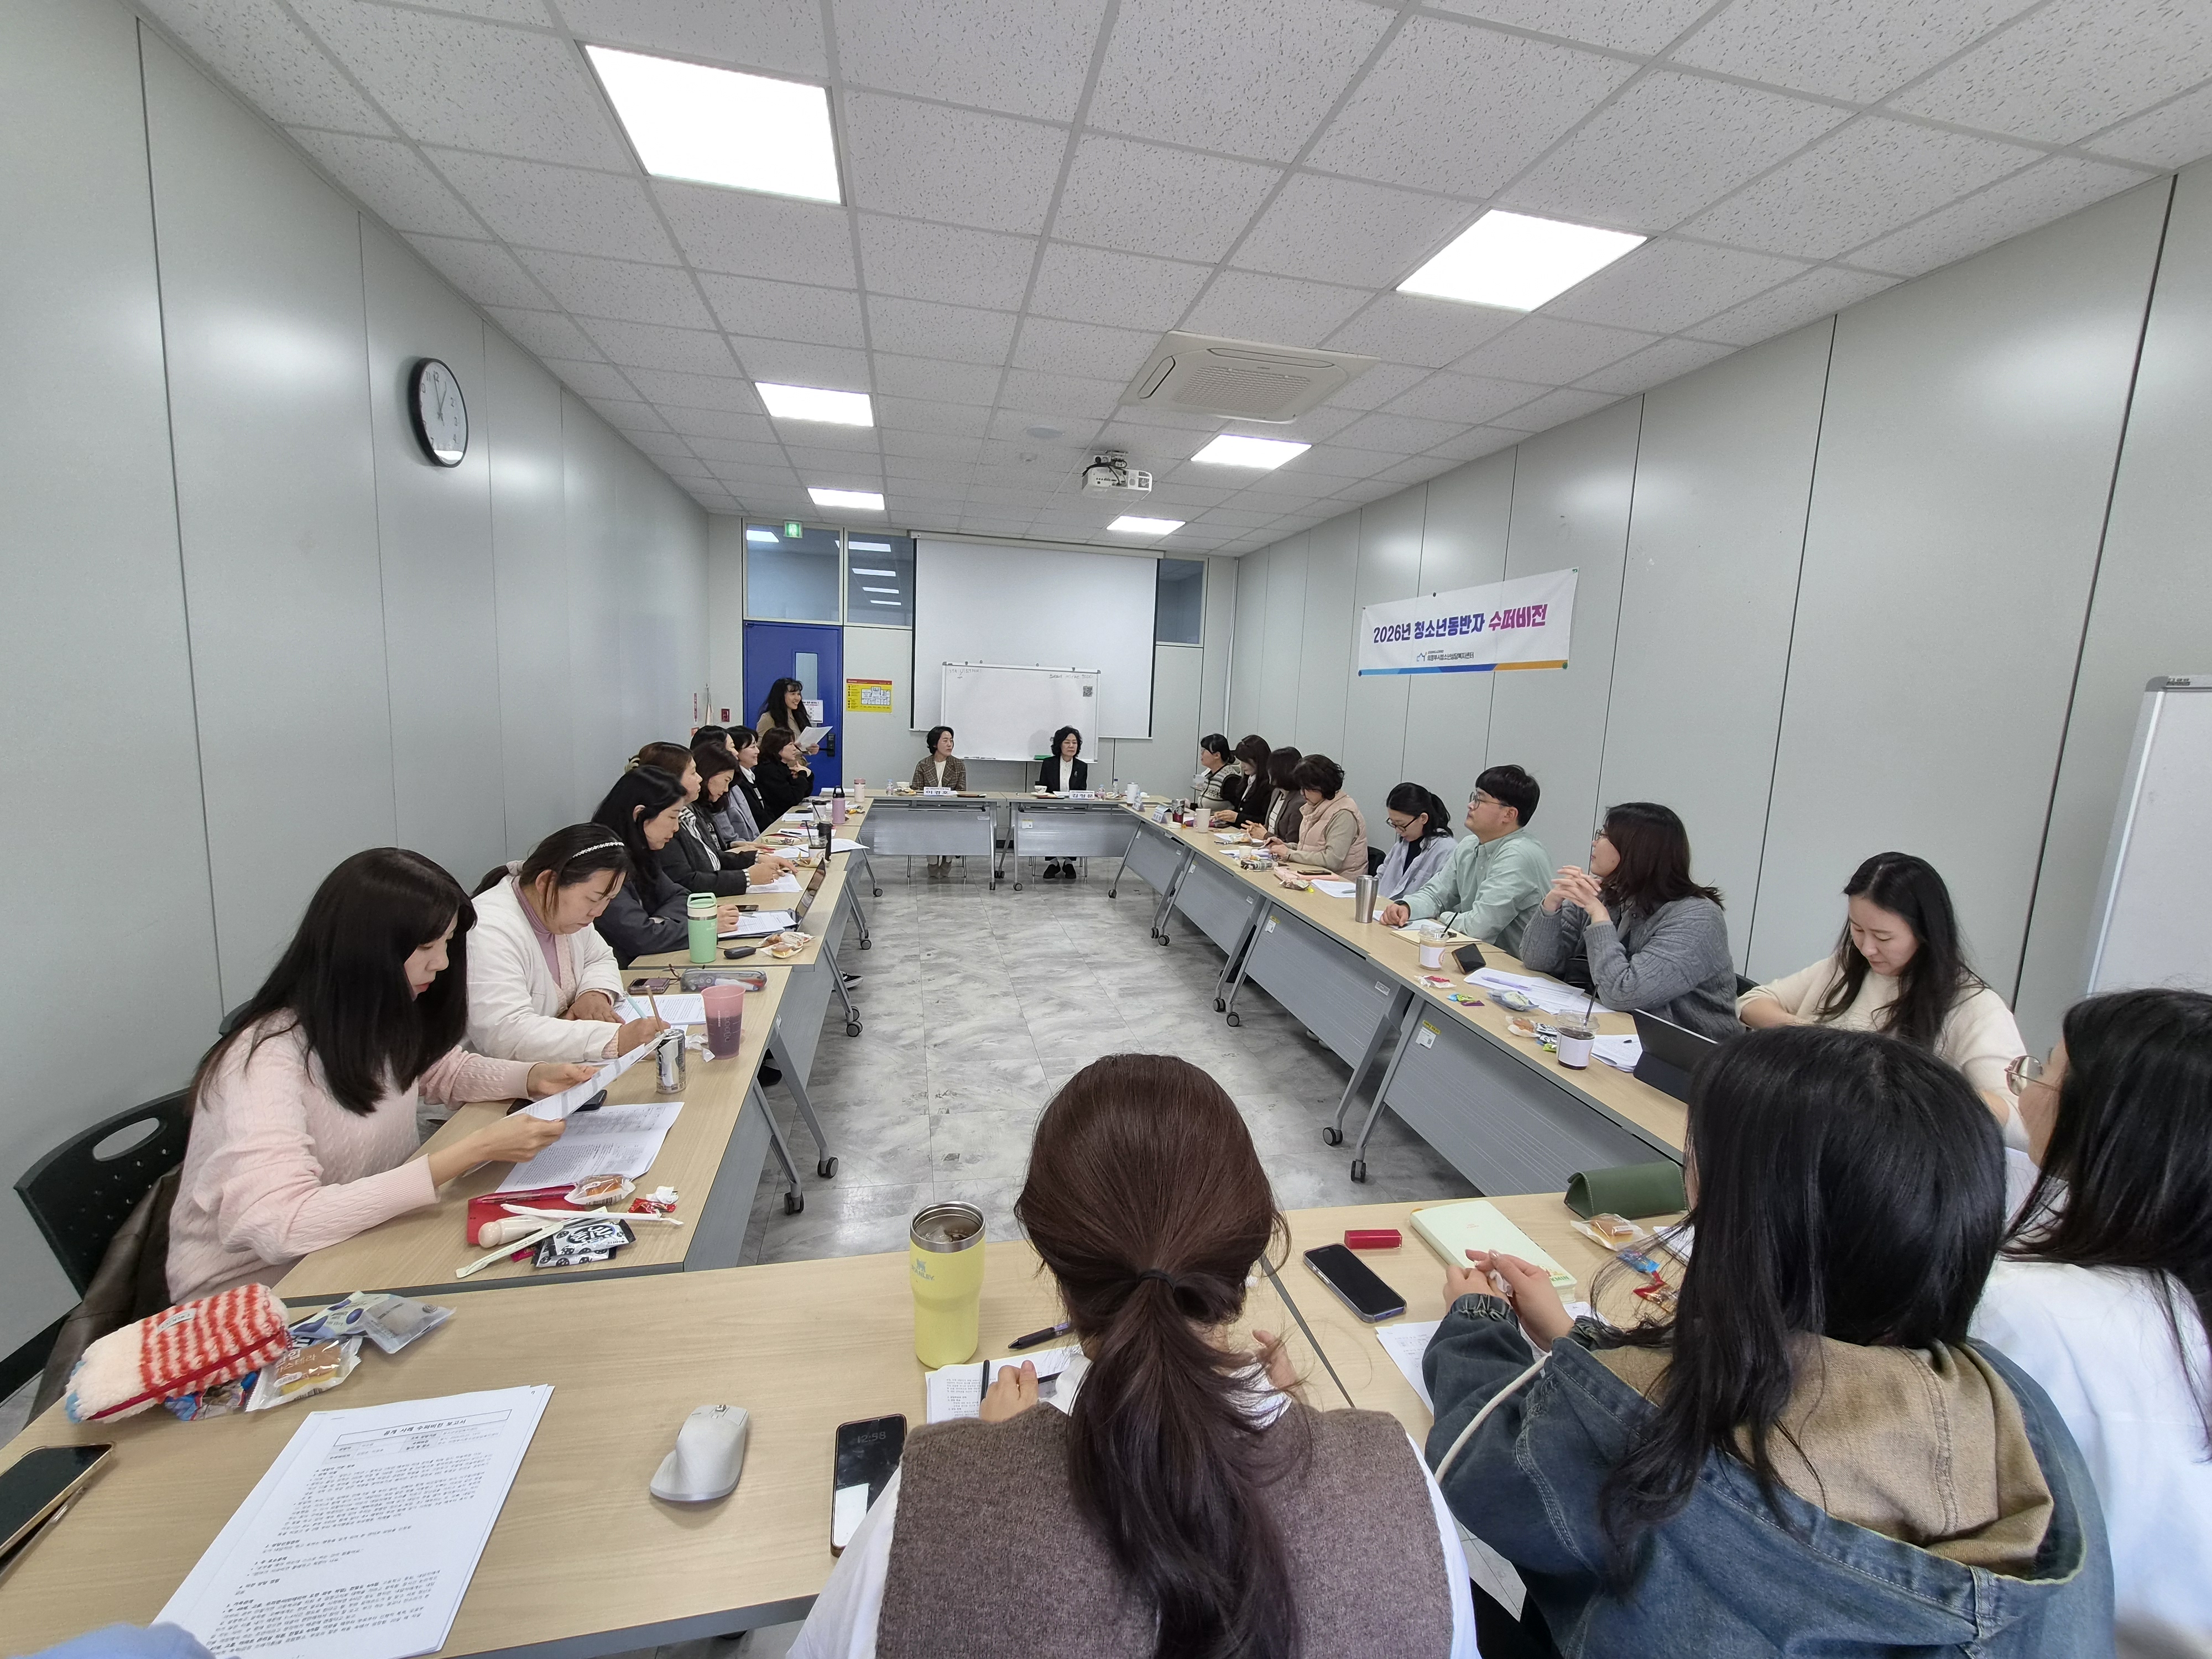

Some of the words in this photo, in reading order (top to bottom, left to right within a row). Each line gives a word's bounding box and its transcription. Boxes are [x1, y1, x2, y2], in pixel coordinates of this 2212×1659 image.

[1374, 623, 1411, 643] 2026년
[1414, 613, 1485, 639] 청소년동반자
[1488, 604, 1548, 631] 수퍼비전
[858, 1431, 886, 1444] 12:58
